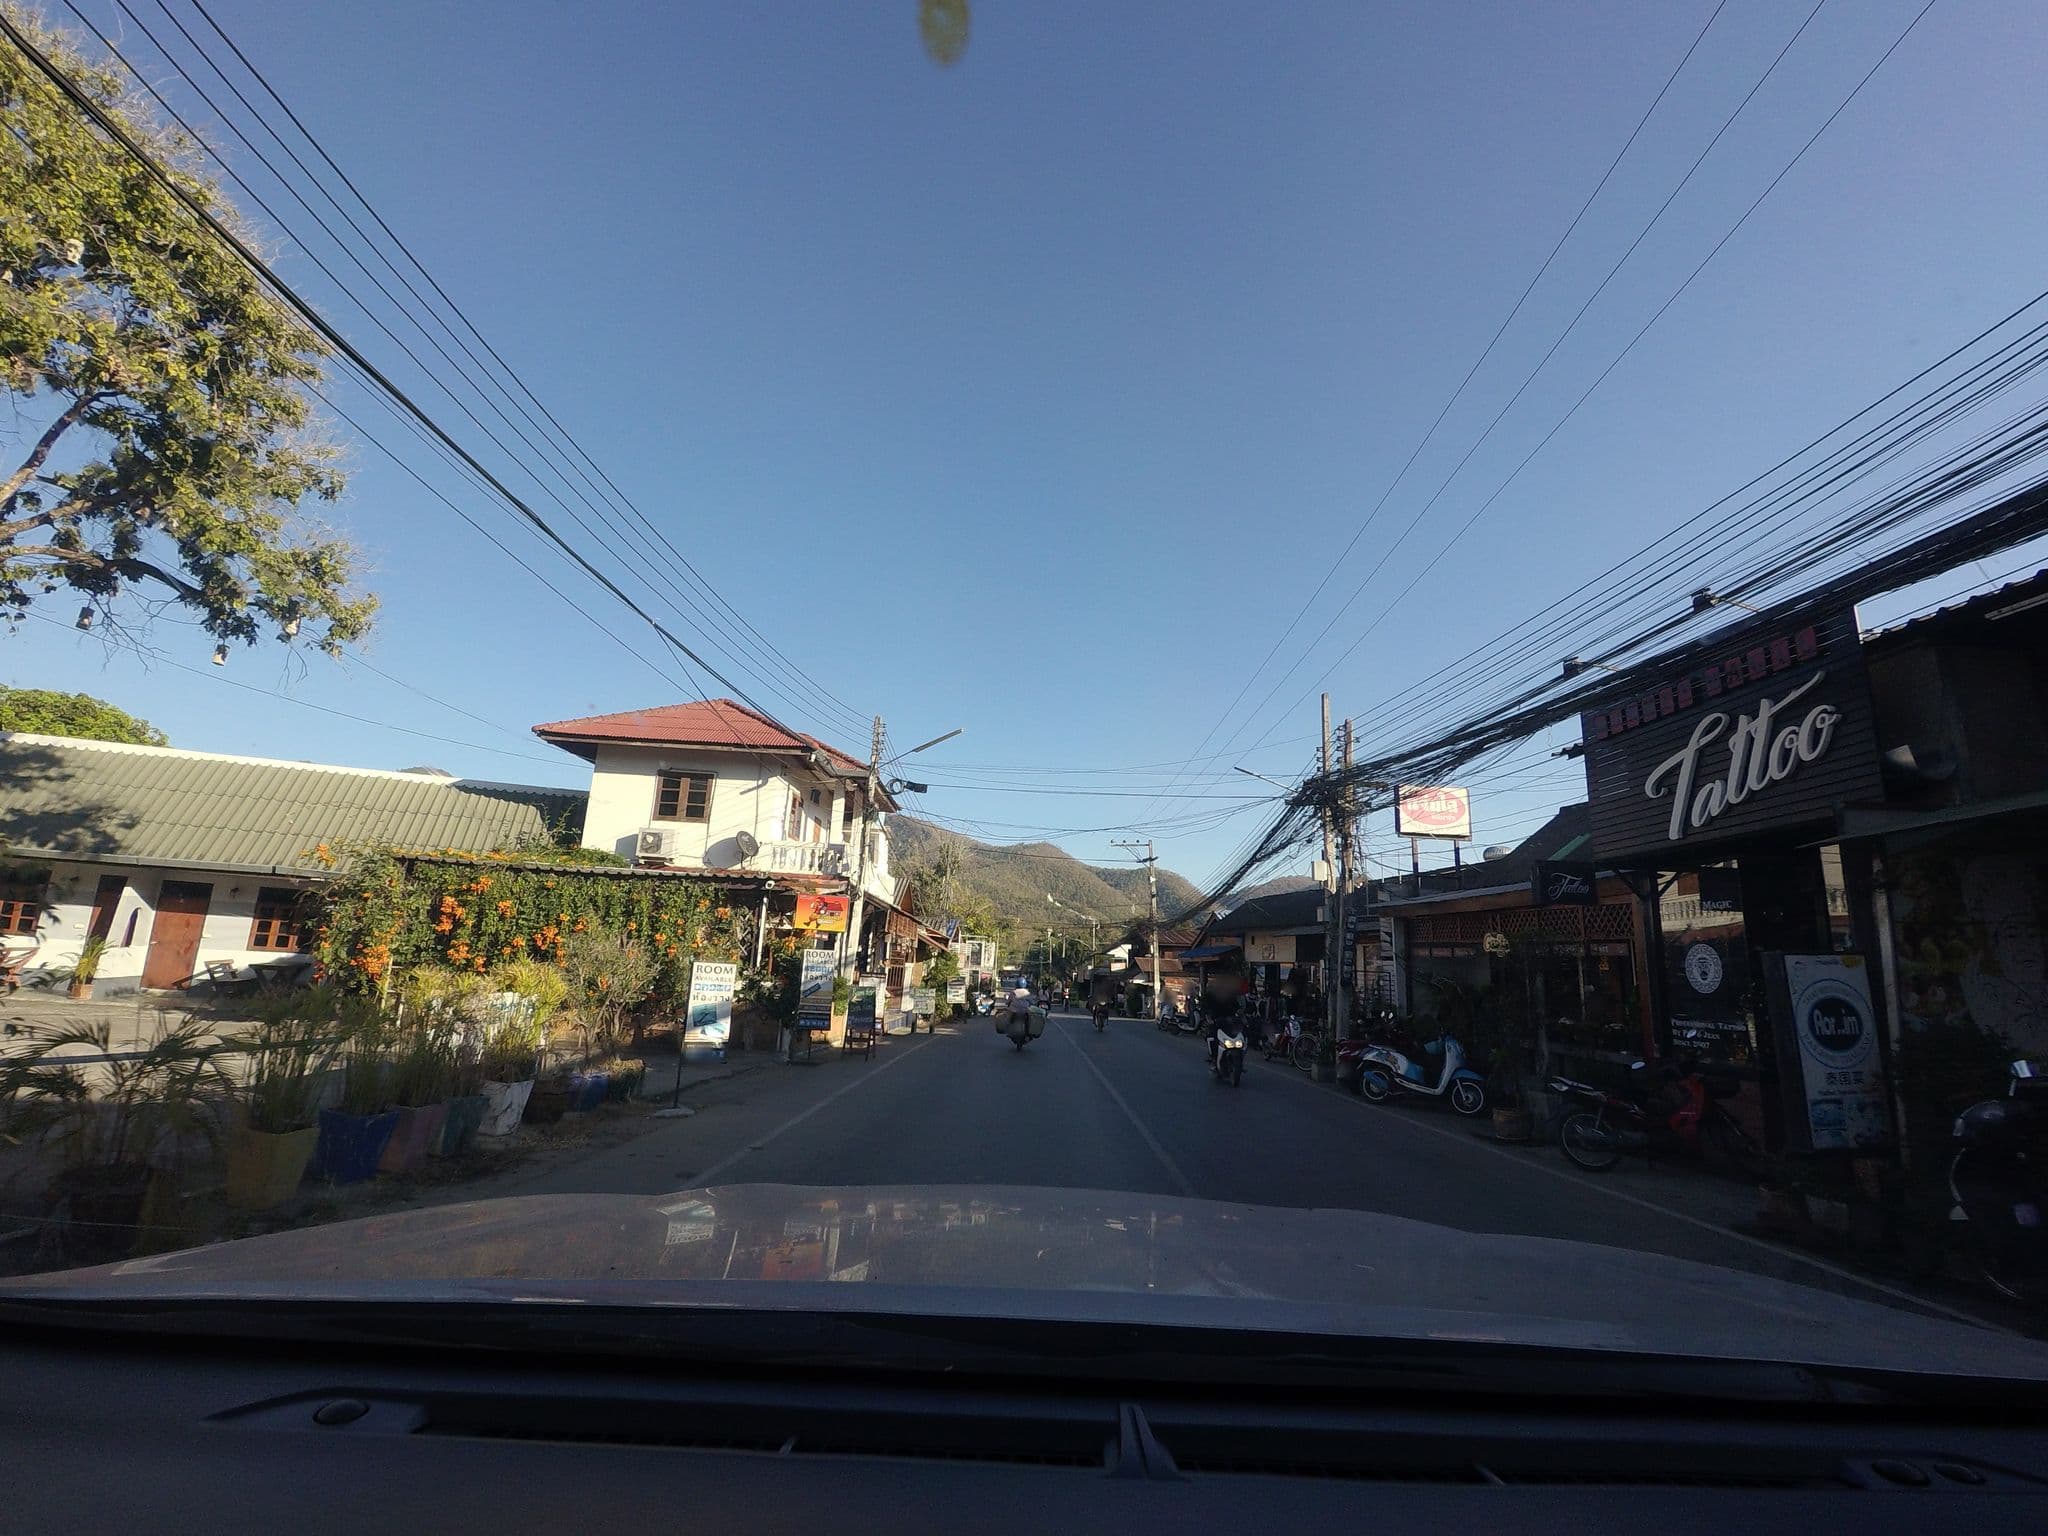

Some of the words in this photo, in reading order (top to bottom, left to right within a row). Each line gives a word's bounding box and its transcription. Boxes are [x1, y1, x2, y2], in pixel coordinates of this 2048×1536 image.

[1645, 671, 1843, 840] Tattoo
[806, 950, 834, 959] ROOM
[696, 964, 733, 974] ROOM
